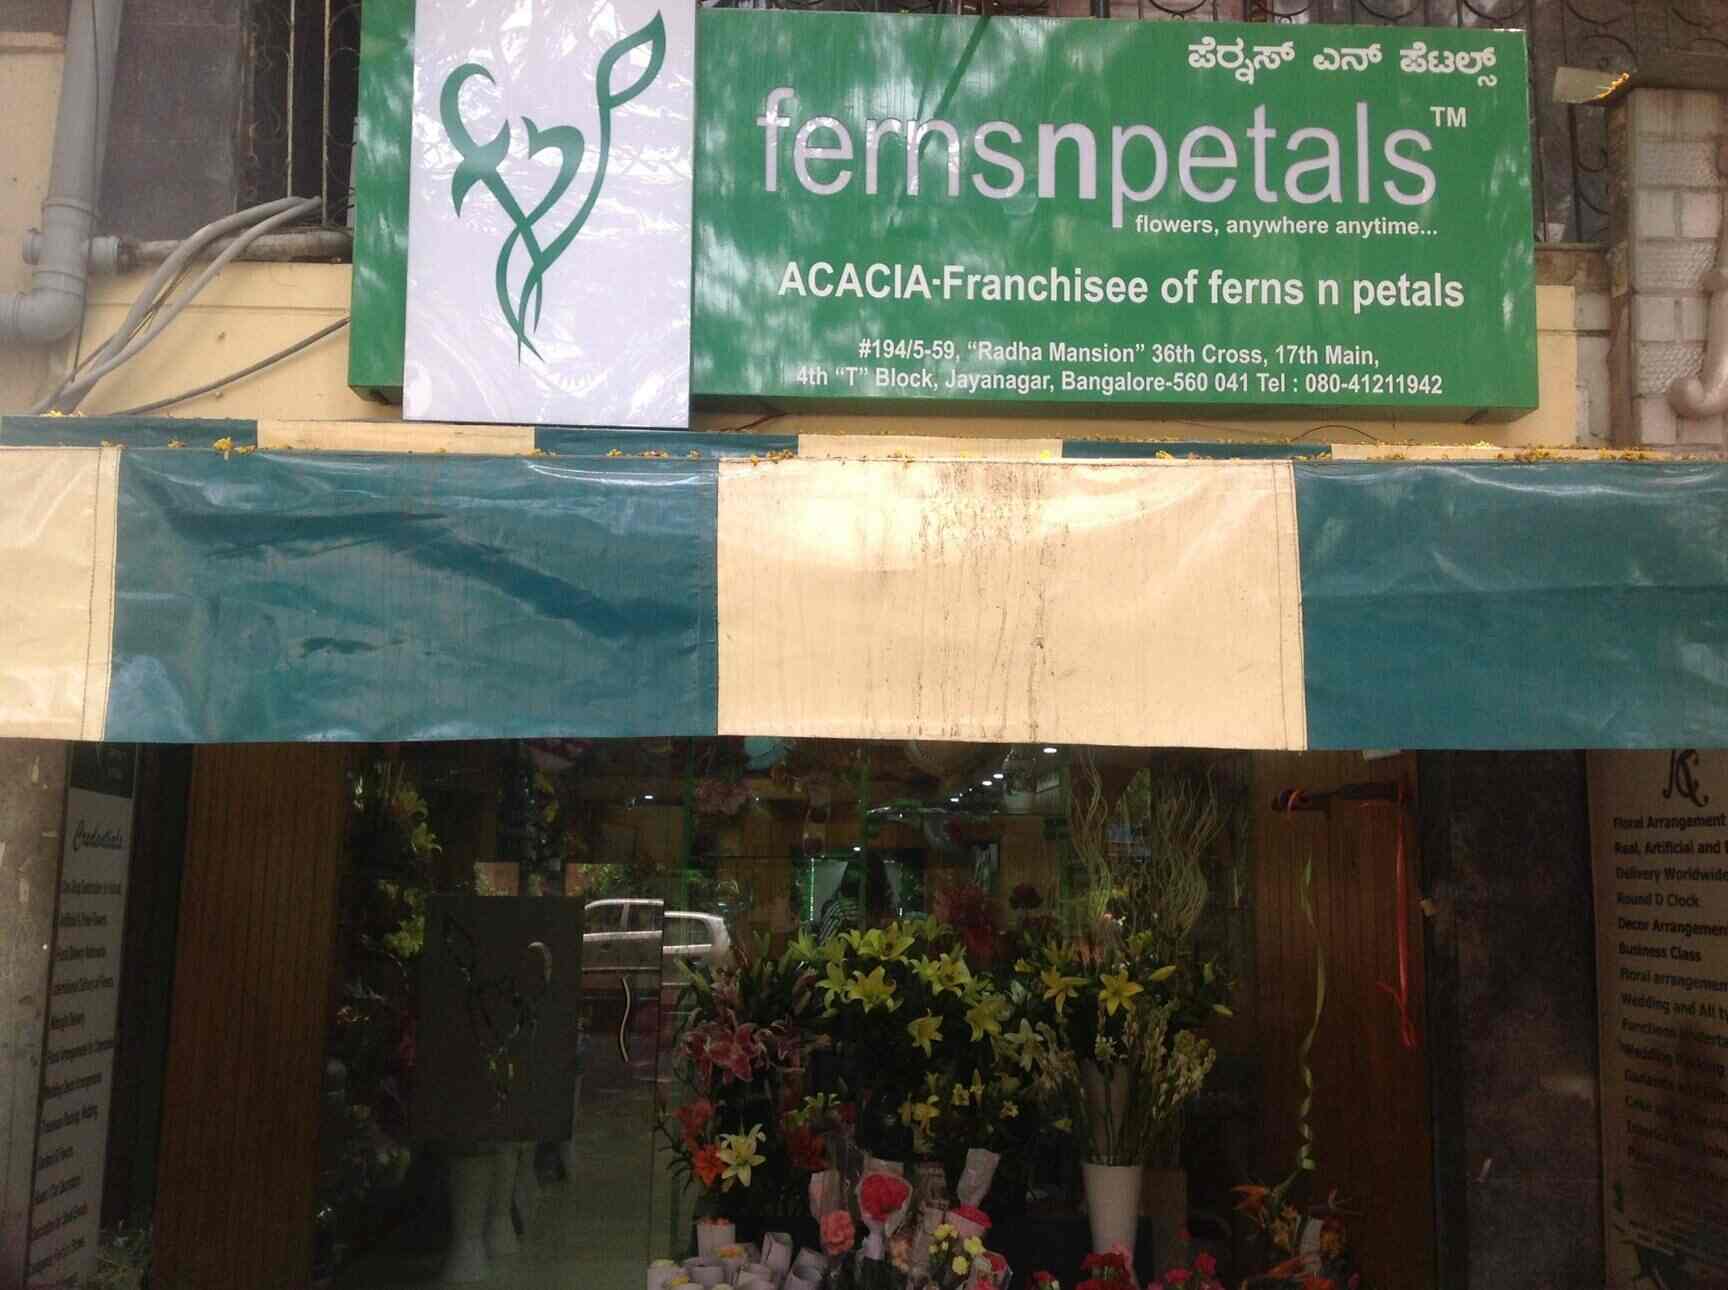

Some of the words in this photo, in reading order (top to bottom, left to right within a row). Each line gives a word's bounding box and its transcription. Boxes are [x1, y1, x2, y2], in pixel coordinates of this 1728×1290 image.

[1312, 43, 1383, 72] ಎನ್
[1429, 106, 1467, 128] TM
[756, 86, 1438, 228] fernsnpetals
[1135, 215, 1219, 237] flowers,
[1226, 217, 1329, 239] anywhere
[1335, 218, 1438, 239] anytime...
[777, 261, 1149, 303] ACACIA-Franchisee
[1160, 269, 1199, 304] of
[1207, 269, 1305, 305] ferns
[1317, 278, 1340, 305] n
[1352, 272, 1465, 315] petals
[858, 338, 961, 361] #194/5-59,
[1151, 343, 1195, 363] 36th
[1201, 344, 1269, 367] Cross,
[1275, 345, 1319, 365] 17th
[1325, 345, 1380, 368] Main,
[796, 366, 829, 386] 4th
[875, 367, 939, 390] Block,
[945, 369, 1055, 394] Jayanagar,
[1061, 371, 1208, 395] Bangalore-560
[1214, 373, 1249, 392] 041
[1256, 373, 1286, 393] Tel
[1304, 374, 1443, 395] 080-41211942
[1647, 813, 1727, 831] Arrangement
[1697, 840, 1721, 854] and
